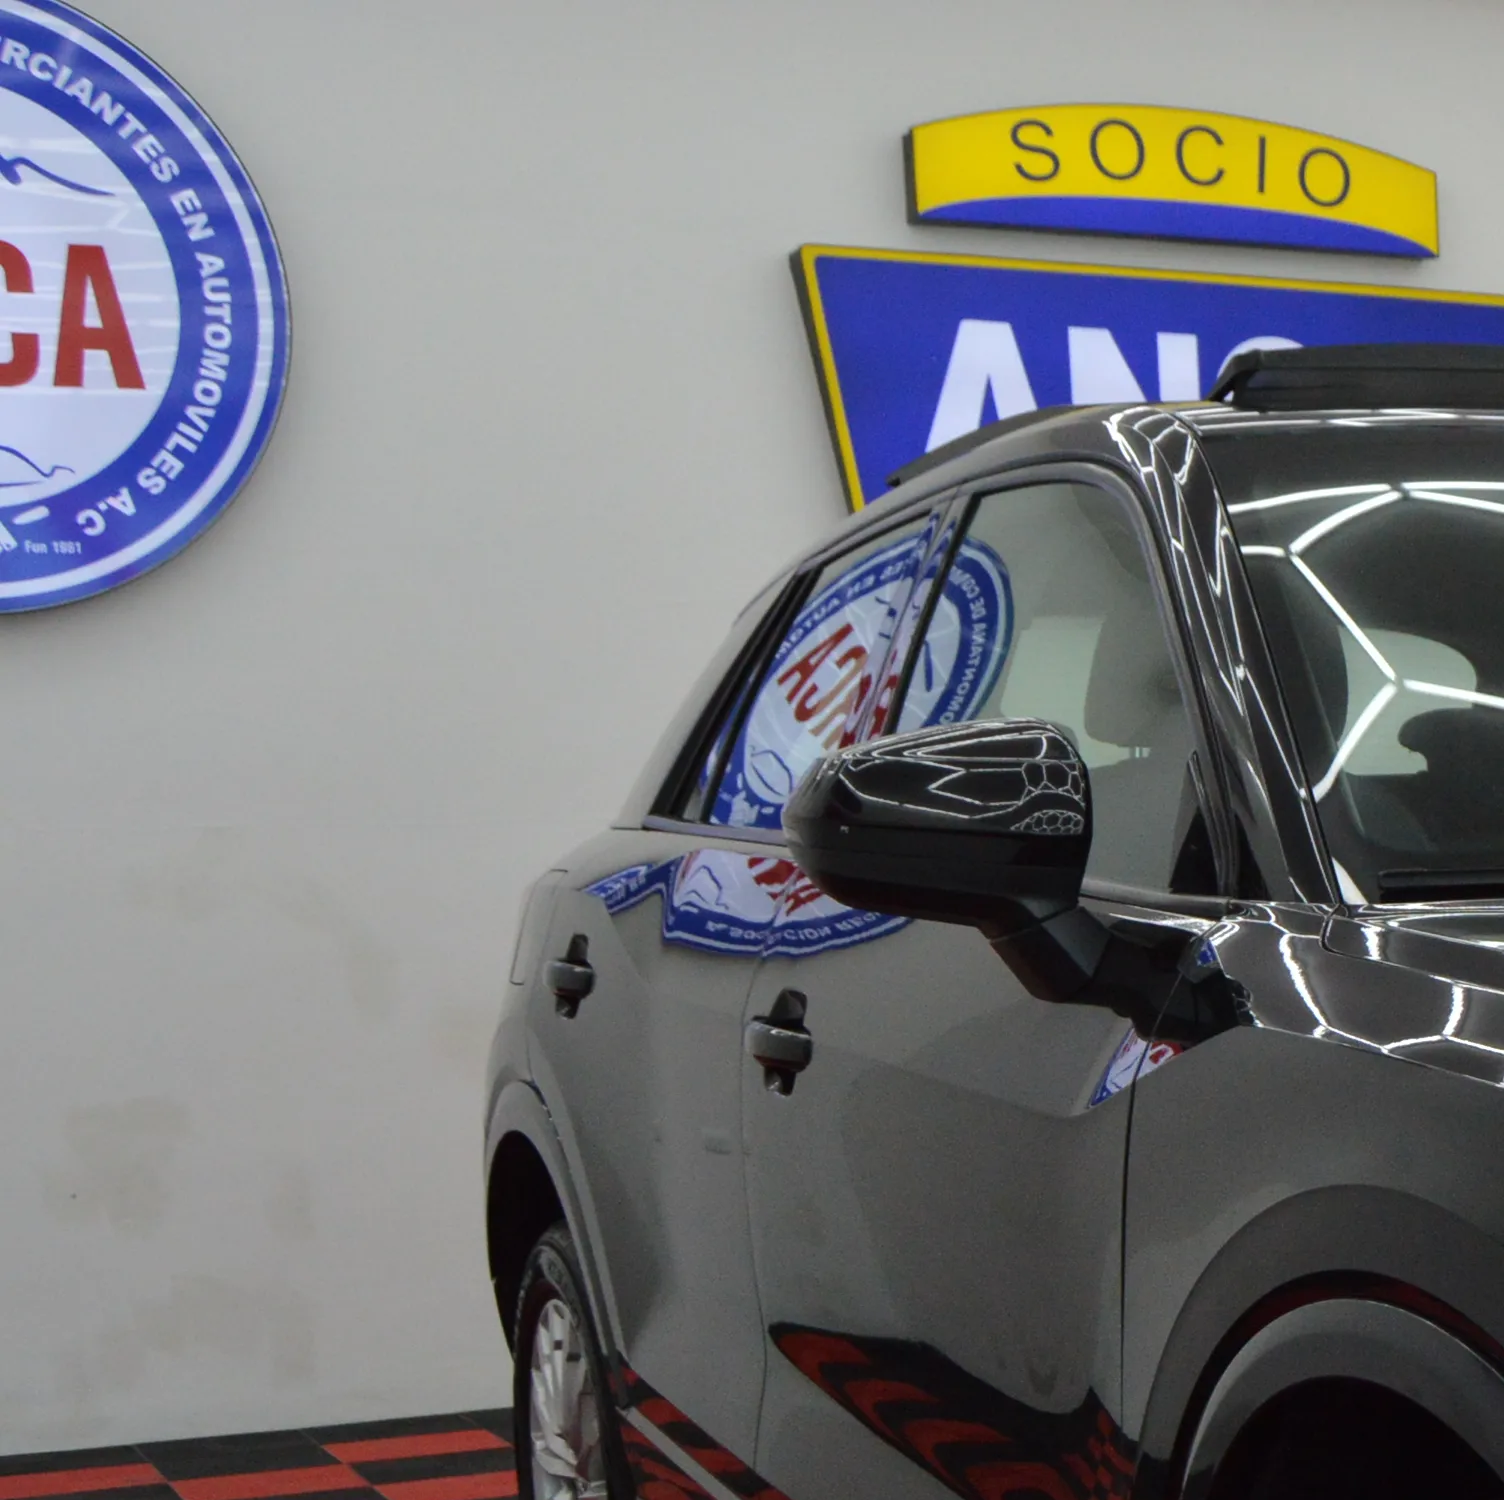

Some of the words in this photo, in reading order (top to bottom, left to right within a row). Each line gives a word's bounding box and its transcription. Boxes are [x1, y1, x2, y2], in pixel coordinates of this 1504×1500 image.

[0, 35, 181, 183] RCIANTES
[1008, 118, 1352, 208] SOCIO
[170, 188, 215, 243] EN
[136, 250, 233, 495] AUTOMOVILES
